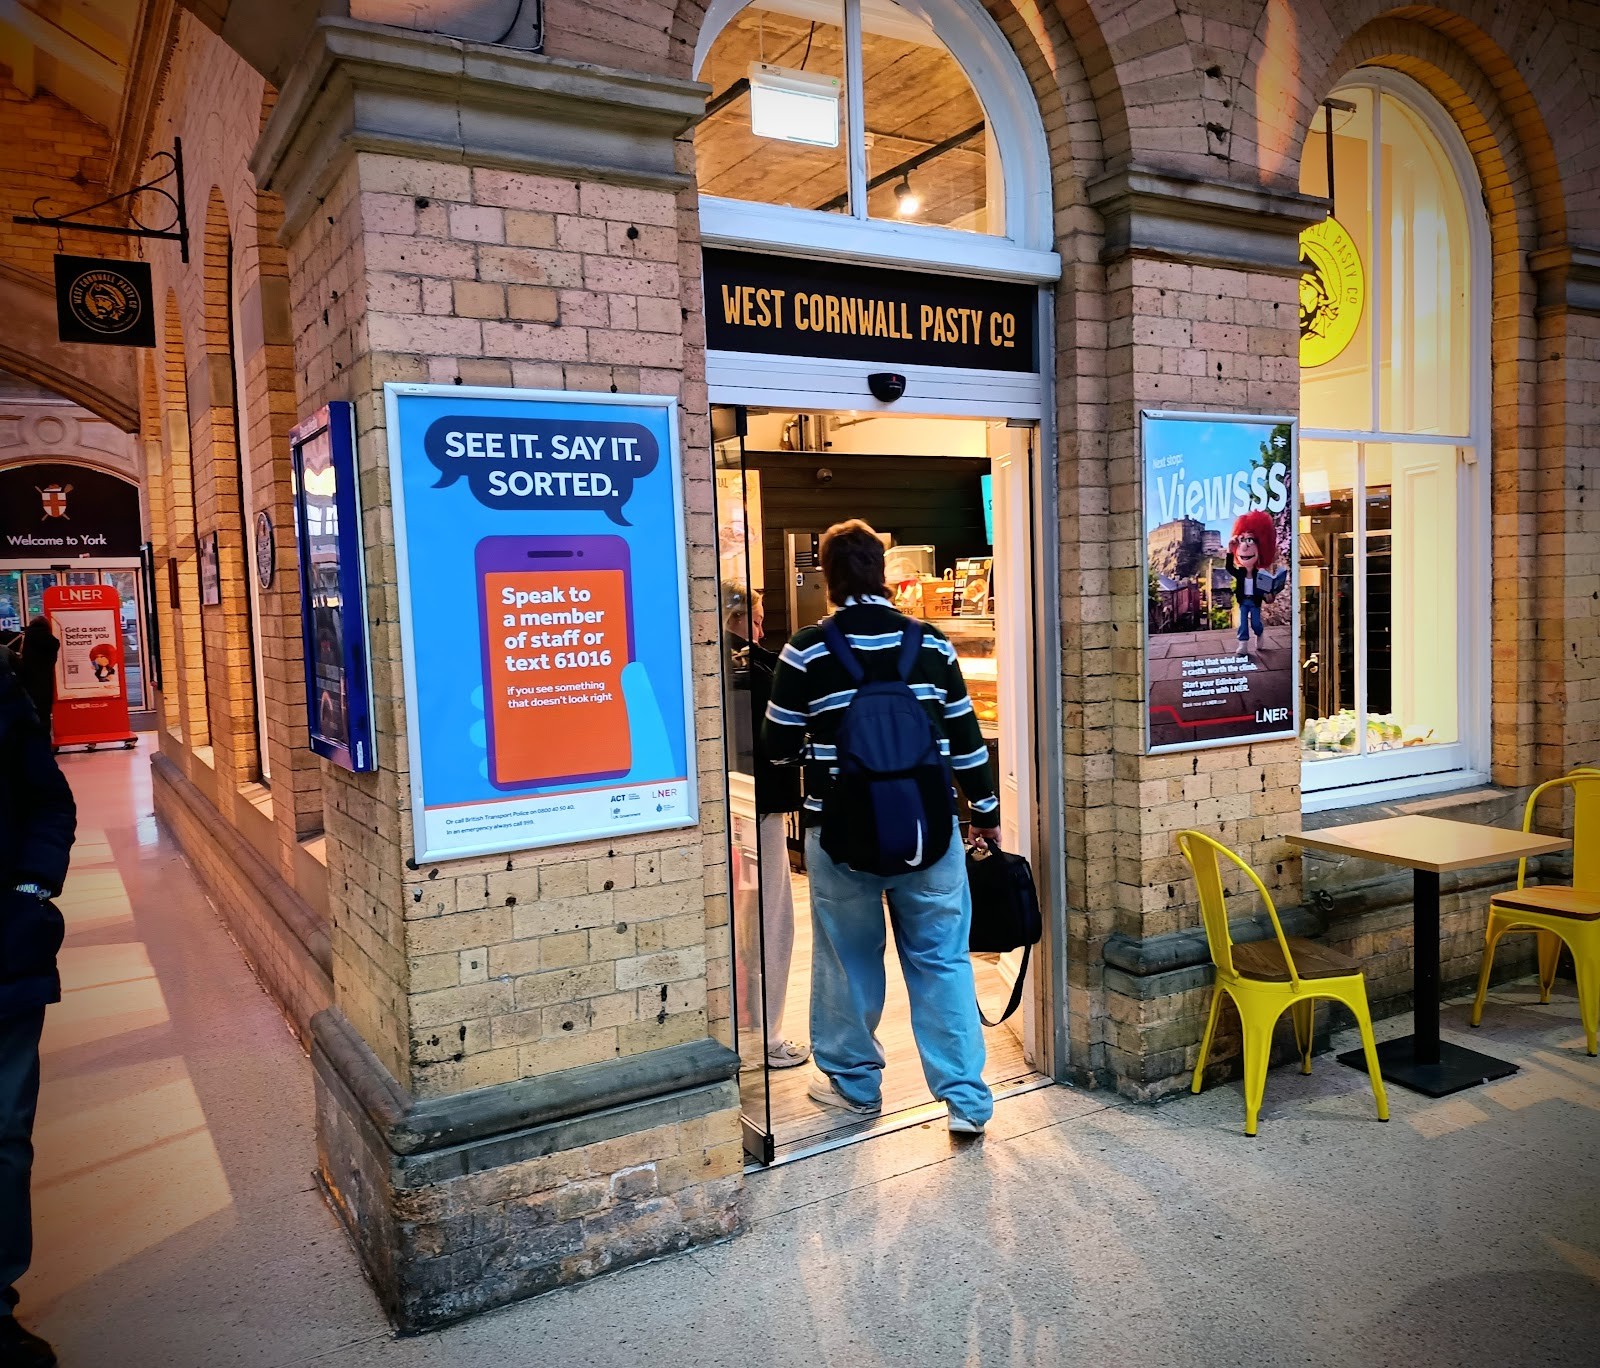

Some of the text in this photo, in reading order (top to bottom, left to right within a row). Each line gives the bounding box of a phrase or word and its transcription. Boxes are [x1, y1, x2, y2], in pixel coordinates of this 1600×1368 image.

[1332, 235, 1357, 277] PASTY
[721, 284, 785, 329] WEST
[794, 292, 913, 340] CORNWALL
[920, 304, 983, 345] PASTY
[445, 431, 641, 461] SEE IT. SAY IT.
[1153, 456, 1167, 469] Next
[488, 470, 618, 497] SORTED.
[7, 534, 107, 546] Welcome to York
[60, 589, 102, 601] LNER
[501, 586, 591, 608] Speak to
[503, 607, 604, 627] a member
[504, 629, 604, 649] of staff or
[505, 650, 612, 672] text 61016
[1181, 655, 1248, 667] Streets that wind and
[1187, 667, 1206, 676] castle
[1207, 665, 1227, 674] worth
[507, 686, 515, 695] if
[515, 686, 534, 697] you
[554, 681, 605, 692] something
[1182, 676, 1248, 689] Start your Edinburgh
[1182, 684, 1250, 698] adventure with LNER.
[508, 692, 613, 708] that doesn't look right
[1255, 707, 1288, 724] LNER
[611, 794, 626, 803] ACT
[652, 788, 677, 799] LNER
[485, 812, 513, 820] Transport
